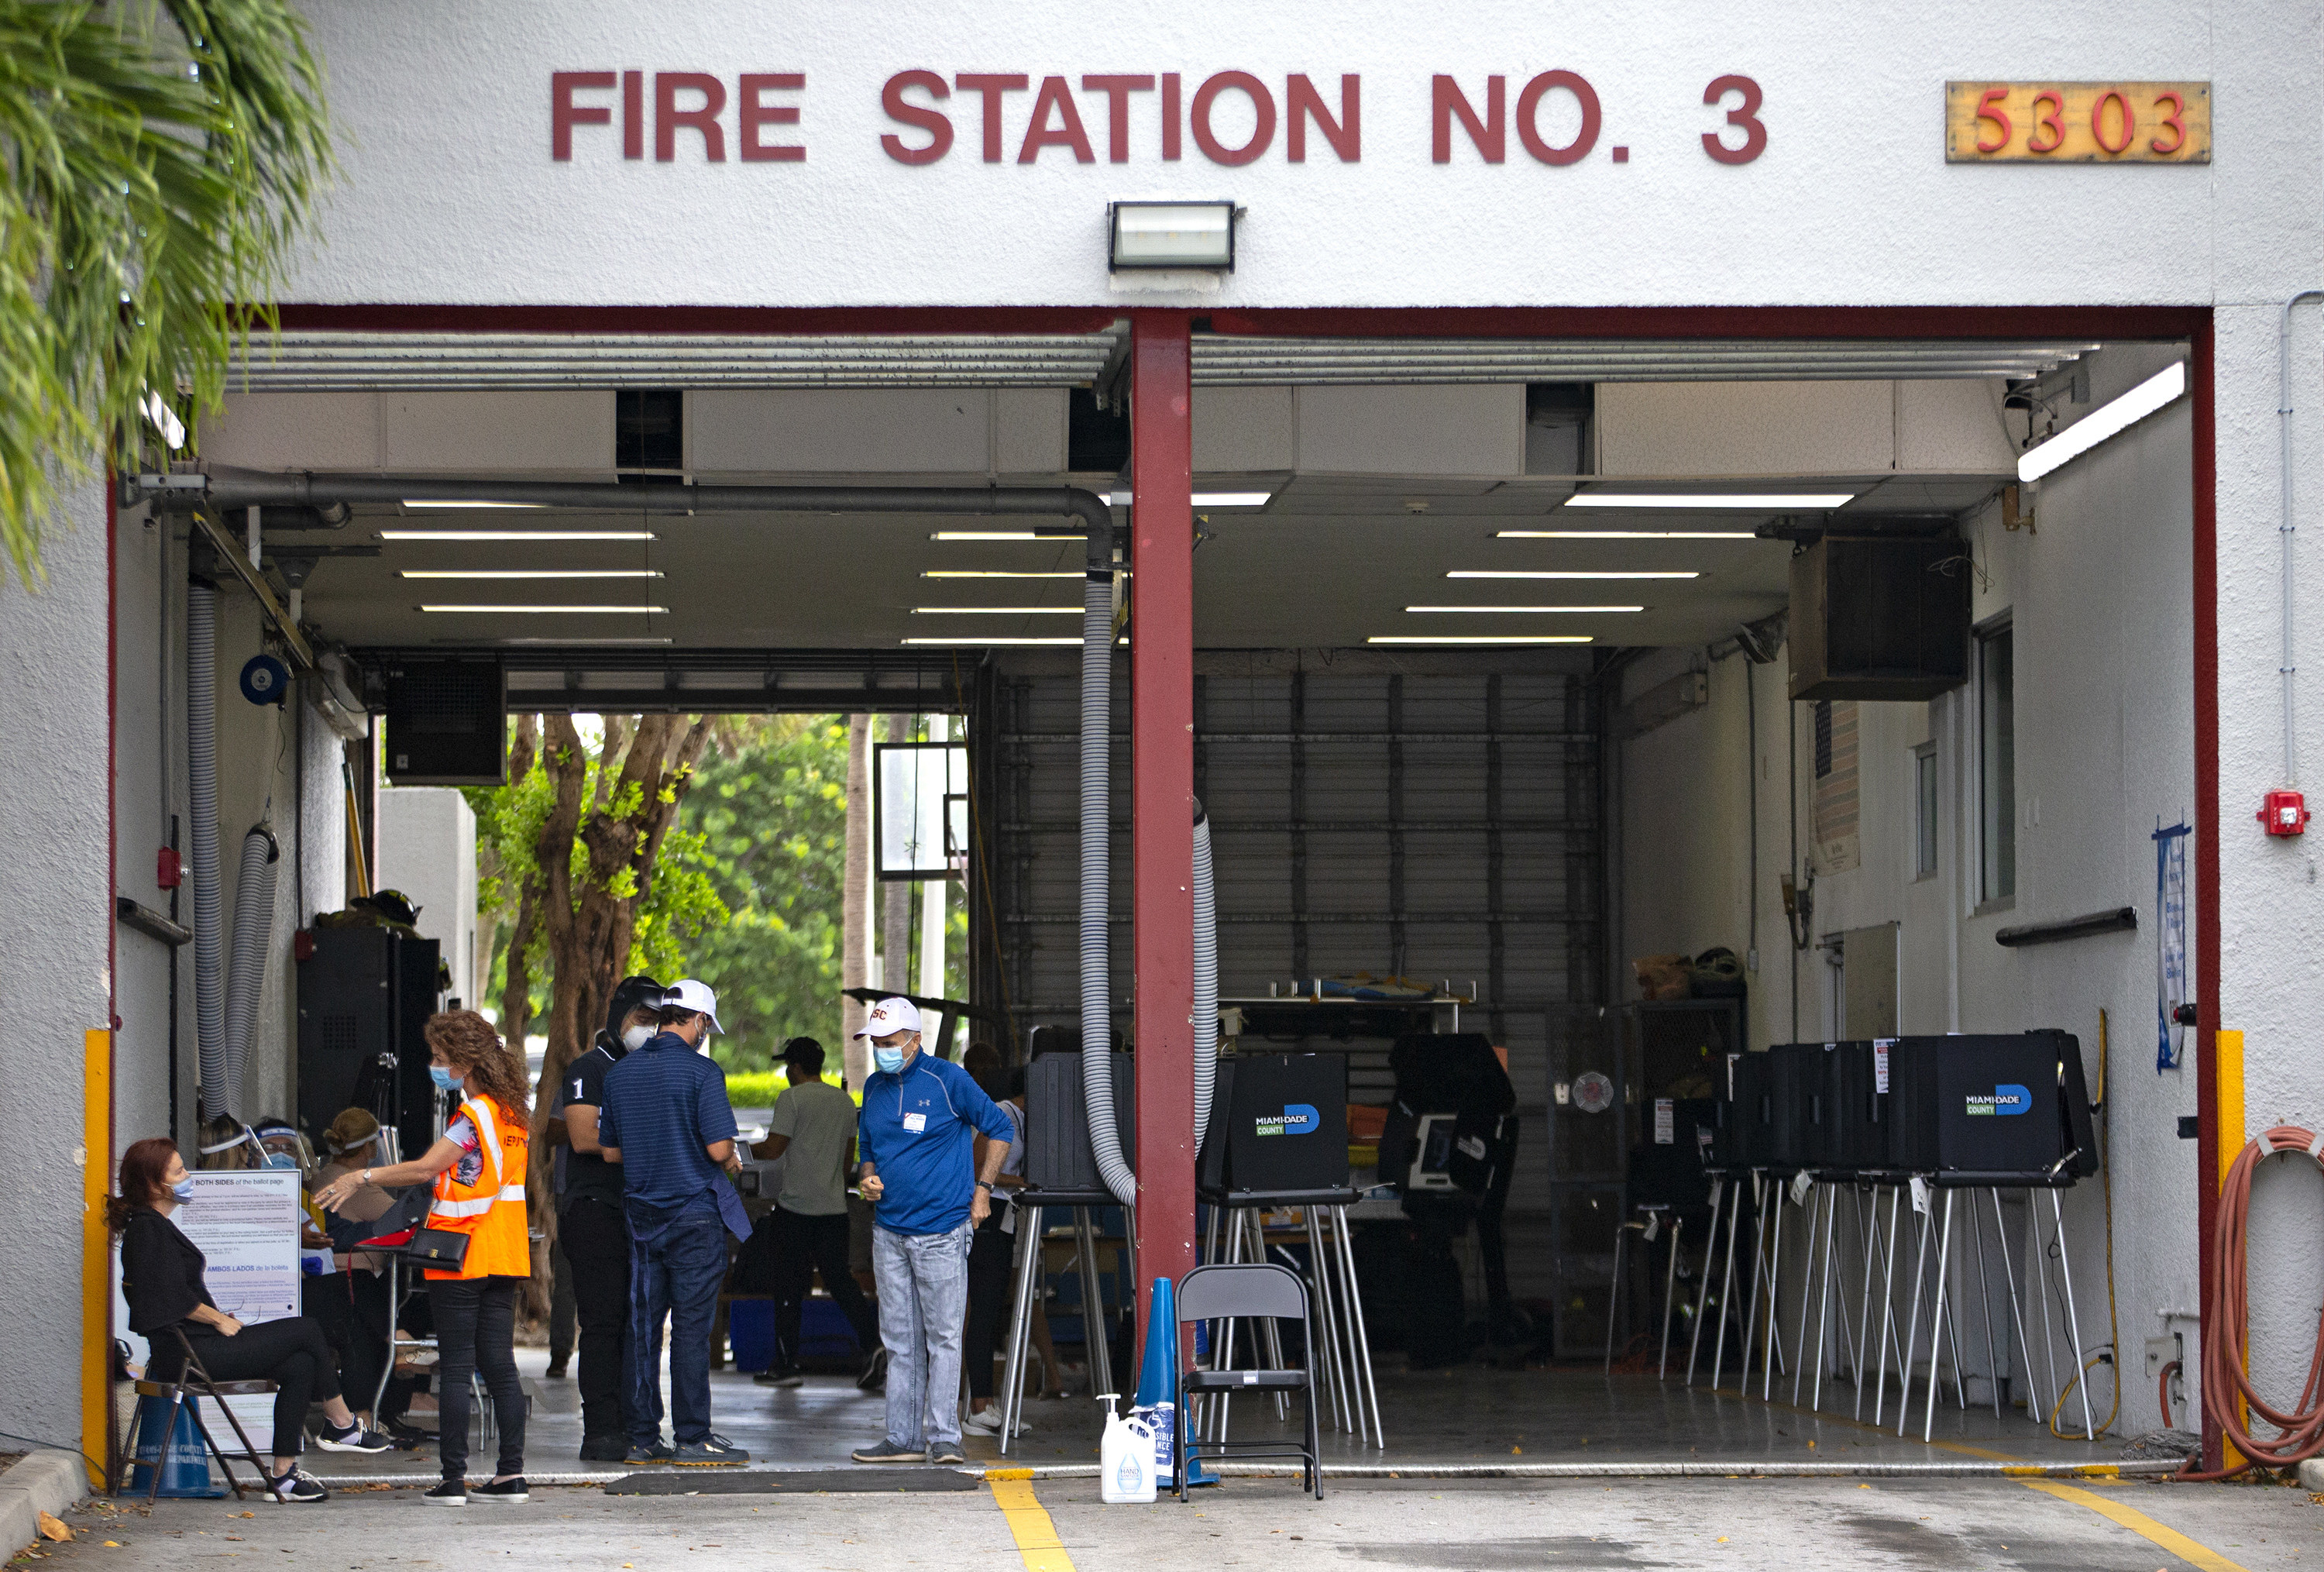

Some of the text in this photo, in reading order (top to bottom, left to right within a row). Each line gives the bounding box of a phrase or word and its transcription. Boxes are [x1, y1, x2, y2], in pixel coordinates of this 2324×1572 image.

[553, 71, 1766, 163] FIRE STATION NO. 3
[1978, 91, 2185, 150] 5303
[871, 1009, 887, 1021] SC
[573, 1078, 583, 1099] 1
[1966, 1095, 2020, 1104] MIAMI-DADE
[1968, 1106, 1995, 1114] COUNTY
[1257, 1116, 1308, 1125] MIAMI-DADE
